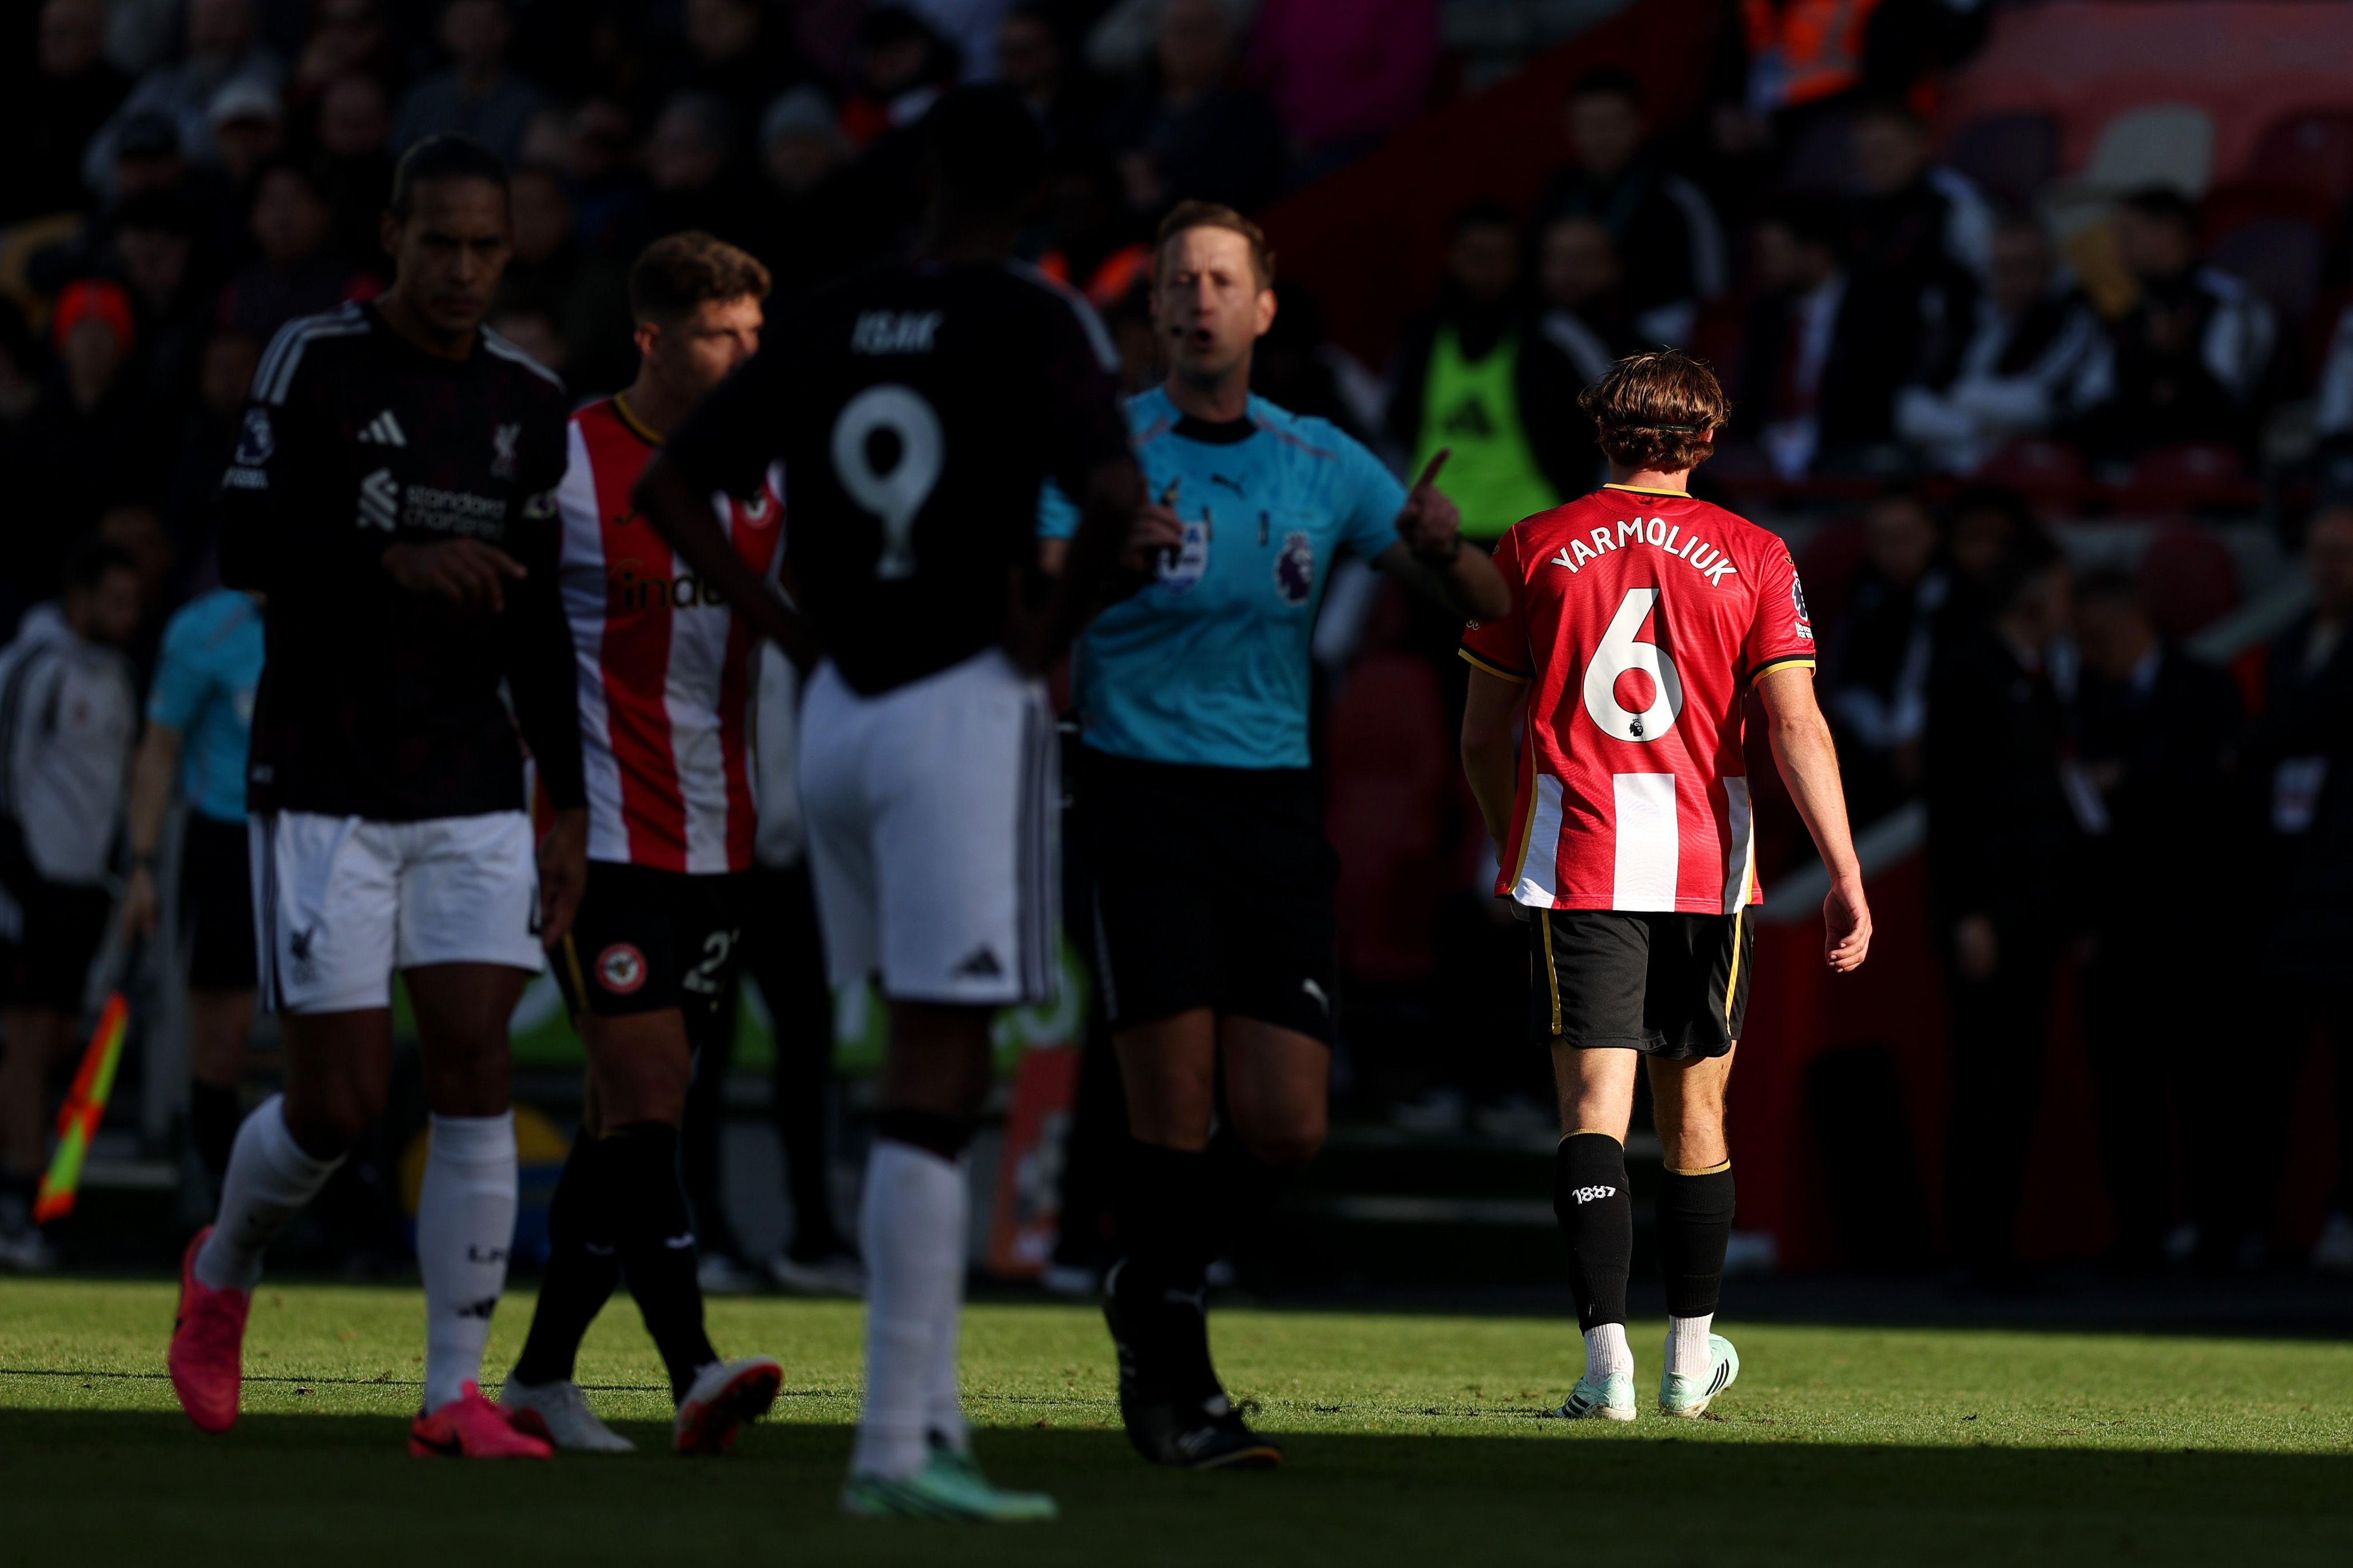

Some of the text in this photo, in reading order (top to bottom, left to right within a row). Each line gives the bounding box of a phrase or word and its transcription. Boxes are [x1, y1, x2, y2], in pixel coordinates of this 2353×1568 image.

[850, 309, 946, 356] ISAK
[406, 483, 507, 520] standard
[828, 380, 947, 583] 9
[1551, 516, 1737, 588] YARMOLIUK
[1583, 588, 1683, 742] 6
[1572, 1185, 1616, 1205] 1887
